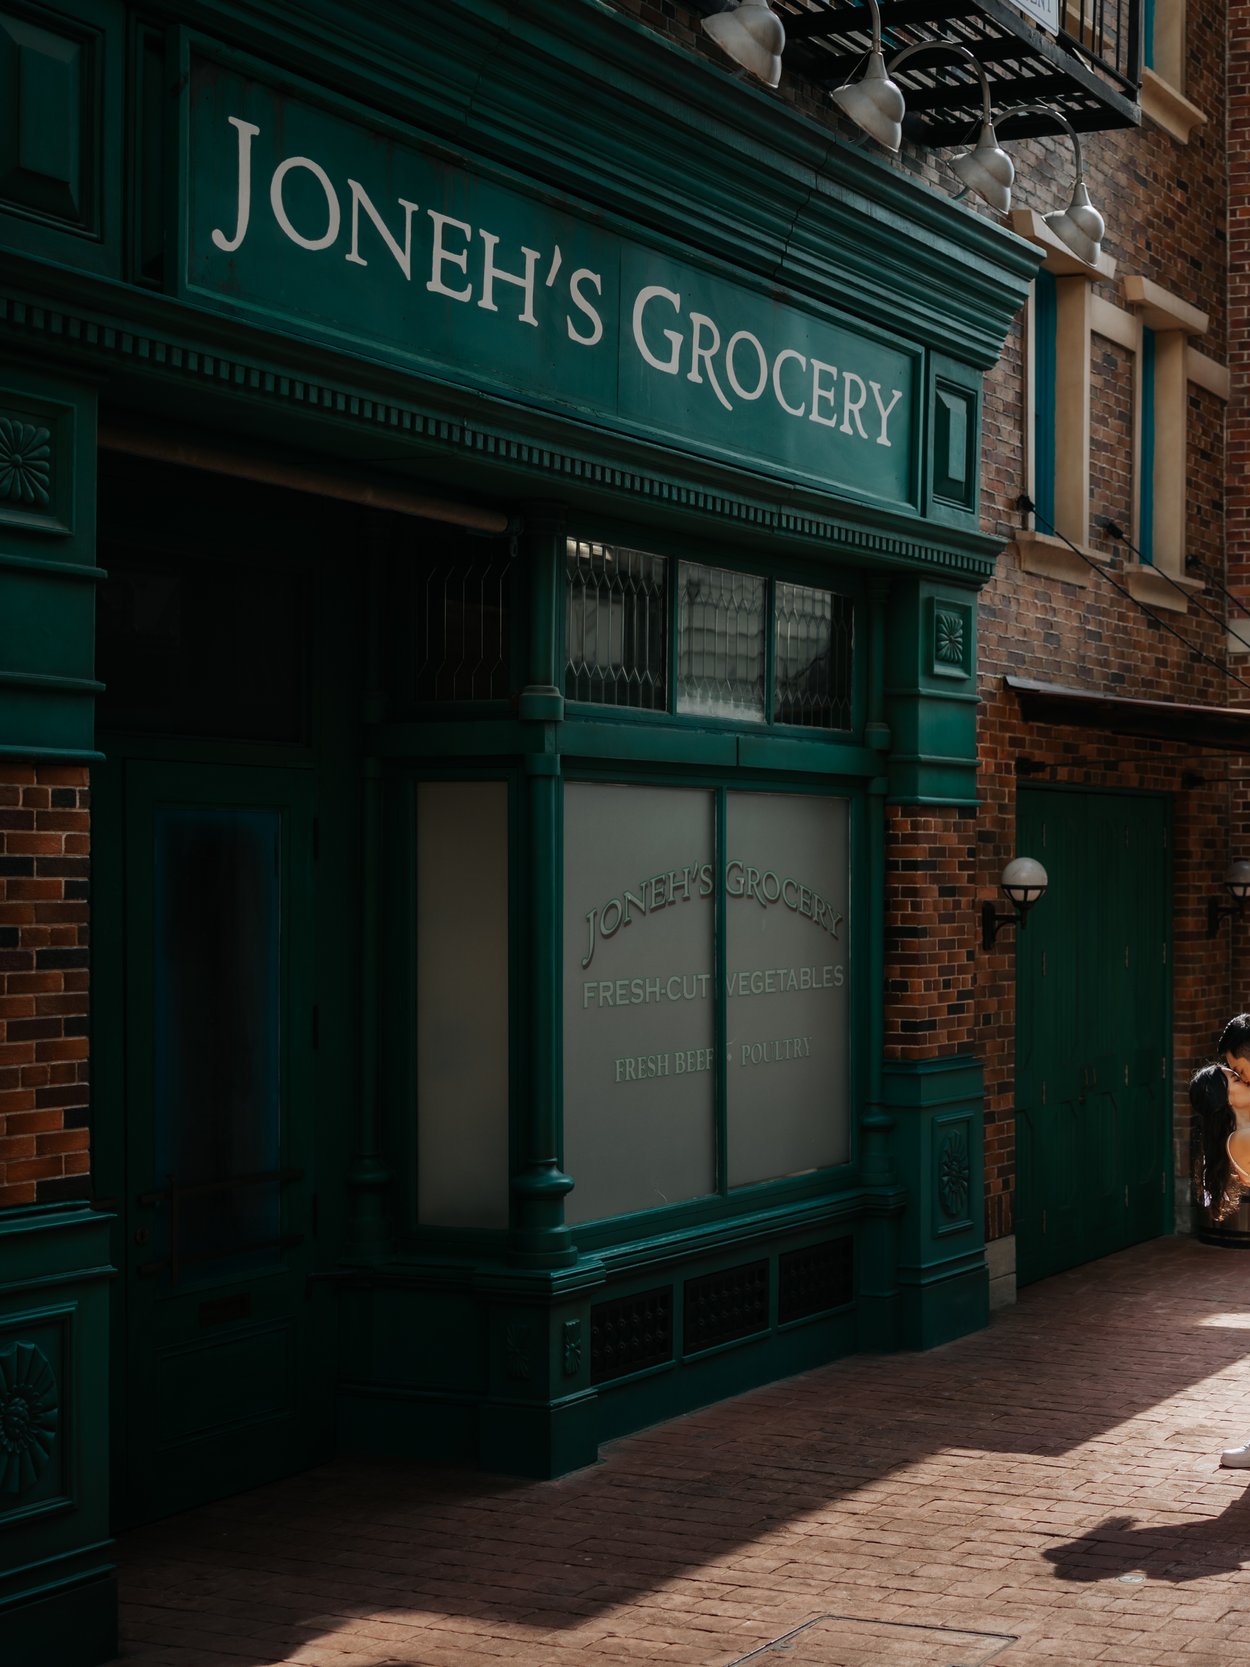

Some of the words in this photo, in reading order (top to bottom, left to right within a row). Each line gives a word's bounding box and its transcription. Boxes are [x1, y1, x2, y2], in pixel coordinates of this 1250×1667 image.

[211, 116, 602, 346] JONEH'S
[632, 286, 903, 447] GROCERY
[581, 861, 714, 969] JONEH'S
[726, 859, 843, 940] GROCERY
[582, 973, 711, 1009] FRESH-CUT
[726, 964, 845, 997] VEGETABLES
[615, 1052, 669, 1082] FRESH
[674, 1047, 714, 1075] BEEF
[741, 1036, 814, 1066] POULTRY
